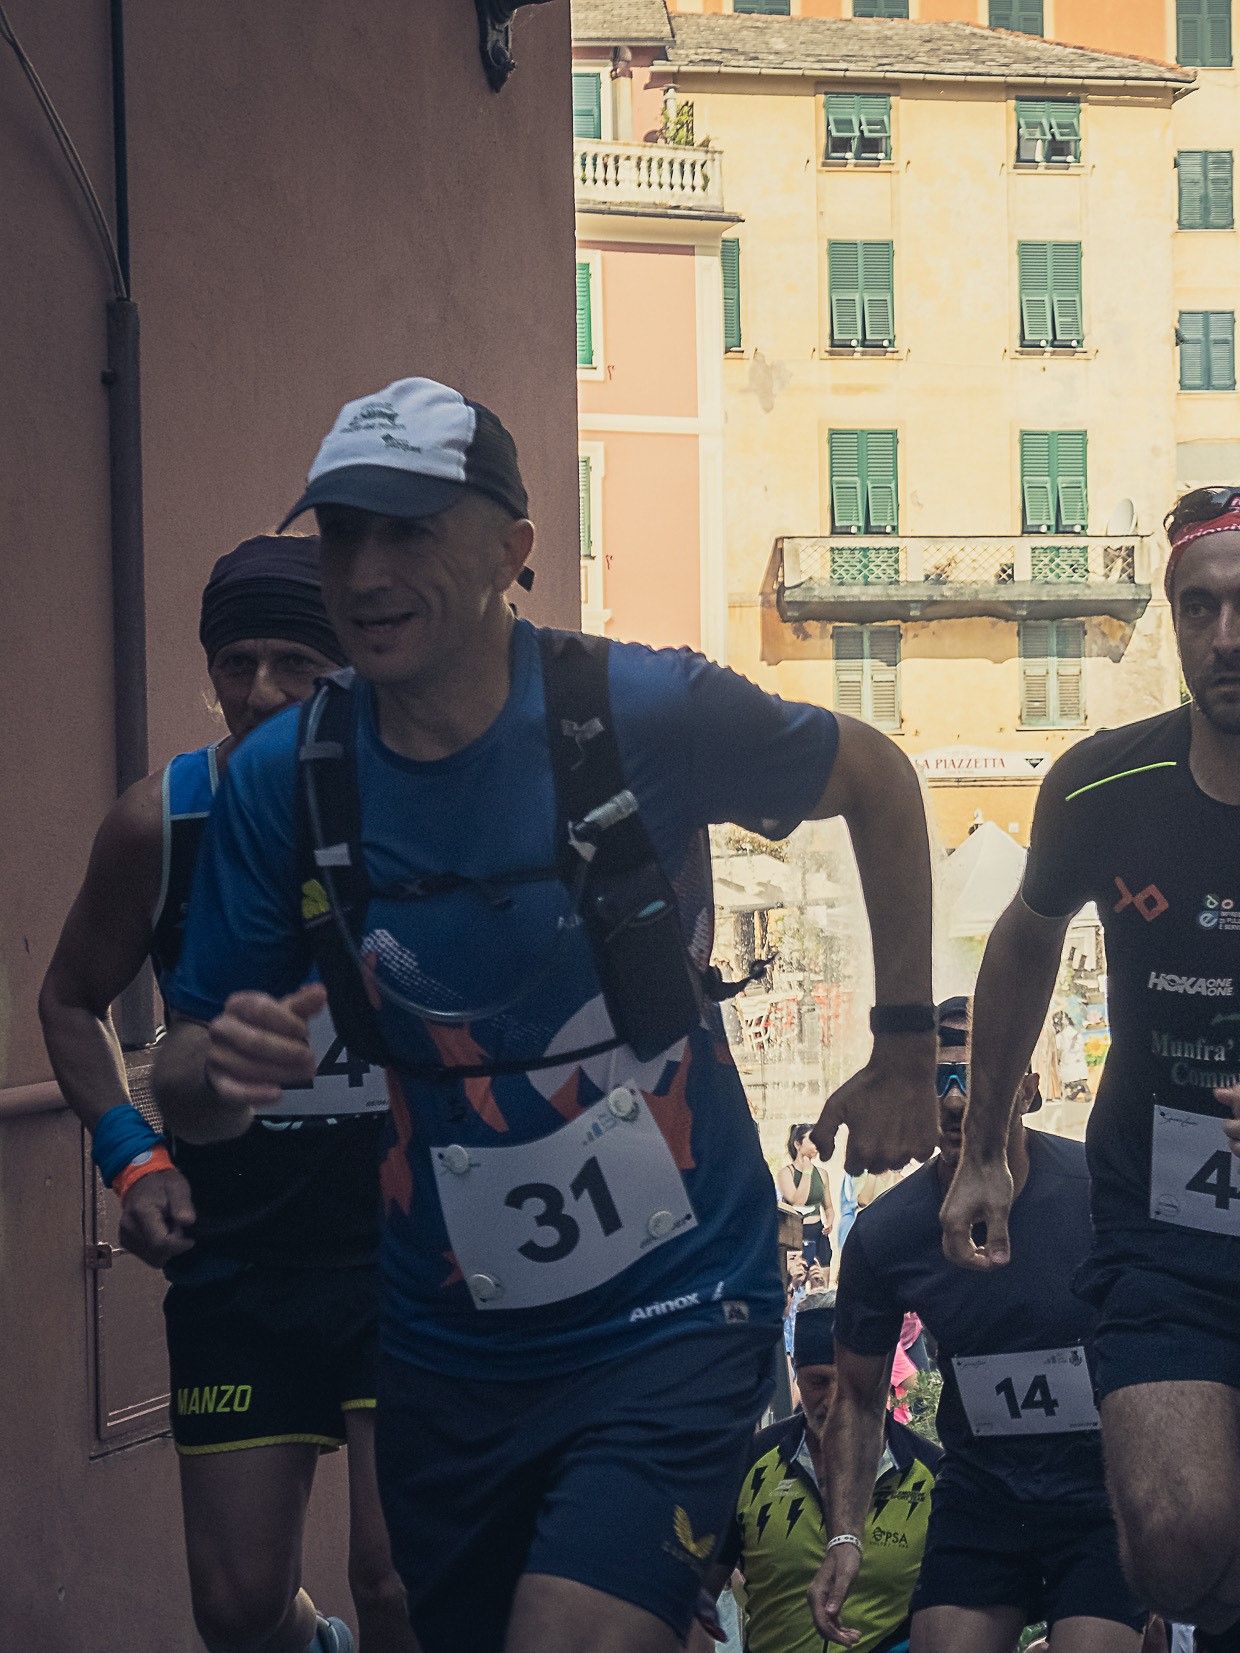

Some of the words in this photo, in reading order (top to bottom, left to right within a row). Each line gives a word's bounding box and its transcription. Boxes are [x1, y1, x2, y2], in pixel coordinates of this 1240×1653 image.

[935, 758, 1006, 769] PIAZZETTA
[1148, 971, 1207, 996] HOKA
[1206, 978, 1233, 988] ONE
[1206, 987, 1234, 997] ONE
[504, 1155, 624, 1264] 31
[994, 1373, 1060, 1420] 14
